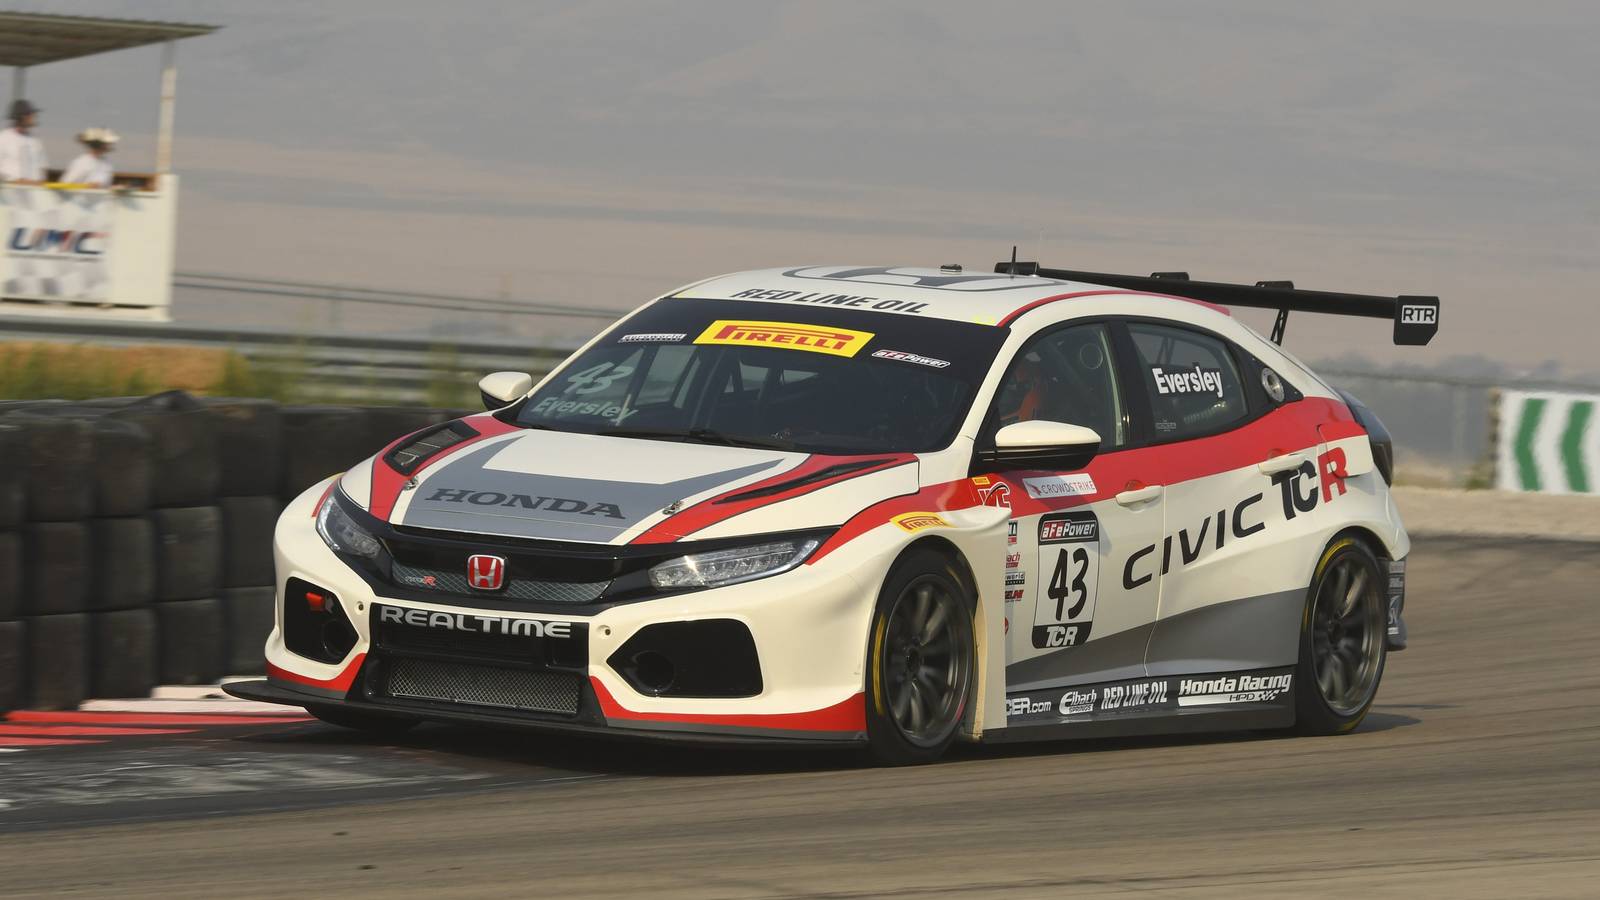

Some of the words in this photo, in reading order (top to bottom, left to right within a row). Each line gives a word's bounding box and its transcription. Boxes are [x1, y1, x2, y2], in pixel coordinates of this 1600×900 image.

[730, 288, 802, 300] RED
[800, 292, 878, 306] LINE
[872, 300, 930, 313] OIL
[1402, 307, 1435, 322] RTR
[713, 325, 856, 350] PIRELLI
[563, 361, 636, 395] 43
[1152, 366, 1223, 398] Eversley
[531, 397, 640, 426] Eversley
[1041, 480, 1096, 495] CROWDSTRIKE
[425, 488, 627, 519] HONDA
[1123, 492, 1266, 590] CIVIC
[1271, 447, 1349, 521] TCR
[1048, 547, 1089, 621] 43
[381, 605, 571, 639] REALTIME
[1045, 626, 1078, 648] TCR
[1101, 686, 1124, 710] RED
[1123, 683, 1150, 707] LINE
[1148, 681, 1168, 703] OIL
[1179, 677, 1237, 695] Honda
[1238, 674, 1292, 692] Racing
[1006, 697, 1052, 716] CER.com
[1059, 689, 1097, 714] Eibach
[1229, 693, 1255, 702] HPD
